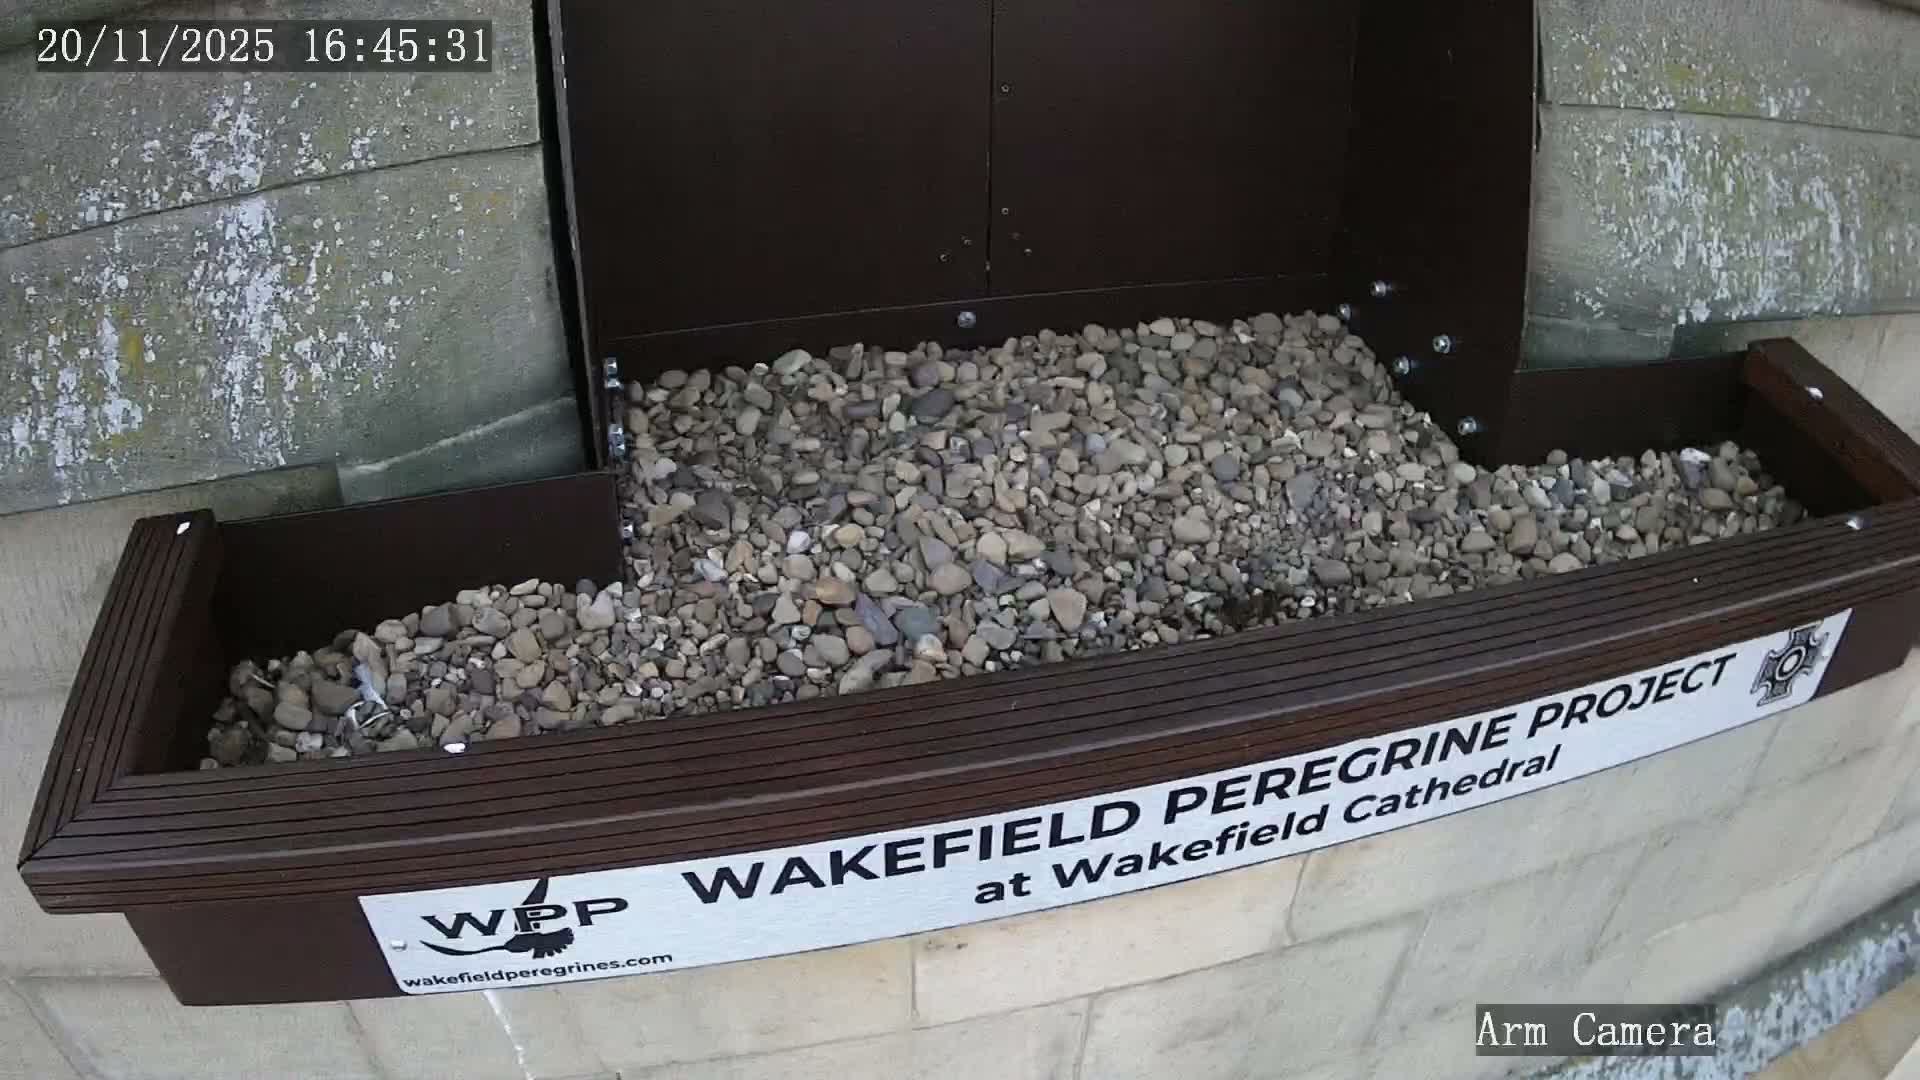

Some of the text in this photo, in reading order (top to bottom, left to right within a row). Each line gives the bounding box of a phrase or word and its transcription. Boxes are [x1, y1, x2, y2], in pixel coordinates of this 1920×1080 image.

[683, 652, 1737, 905] WAKEFIELD PEREGRINE PROJECT
[975, 744, 1563, 905] at Wakefield Cathedral
[420, 897, 629, 939] WPP
[403, 952, 673, 988] wakefieldperegrines.com
